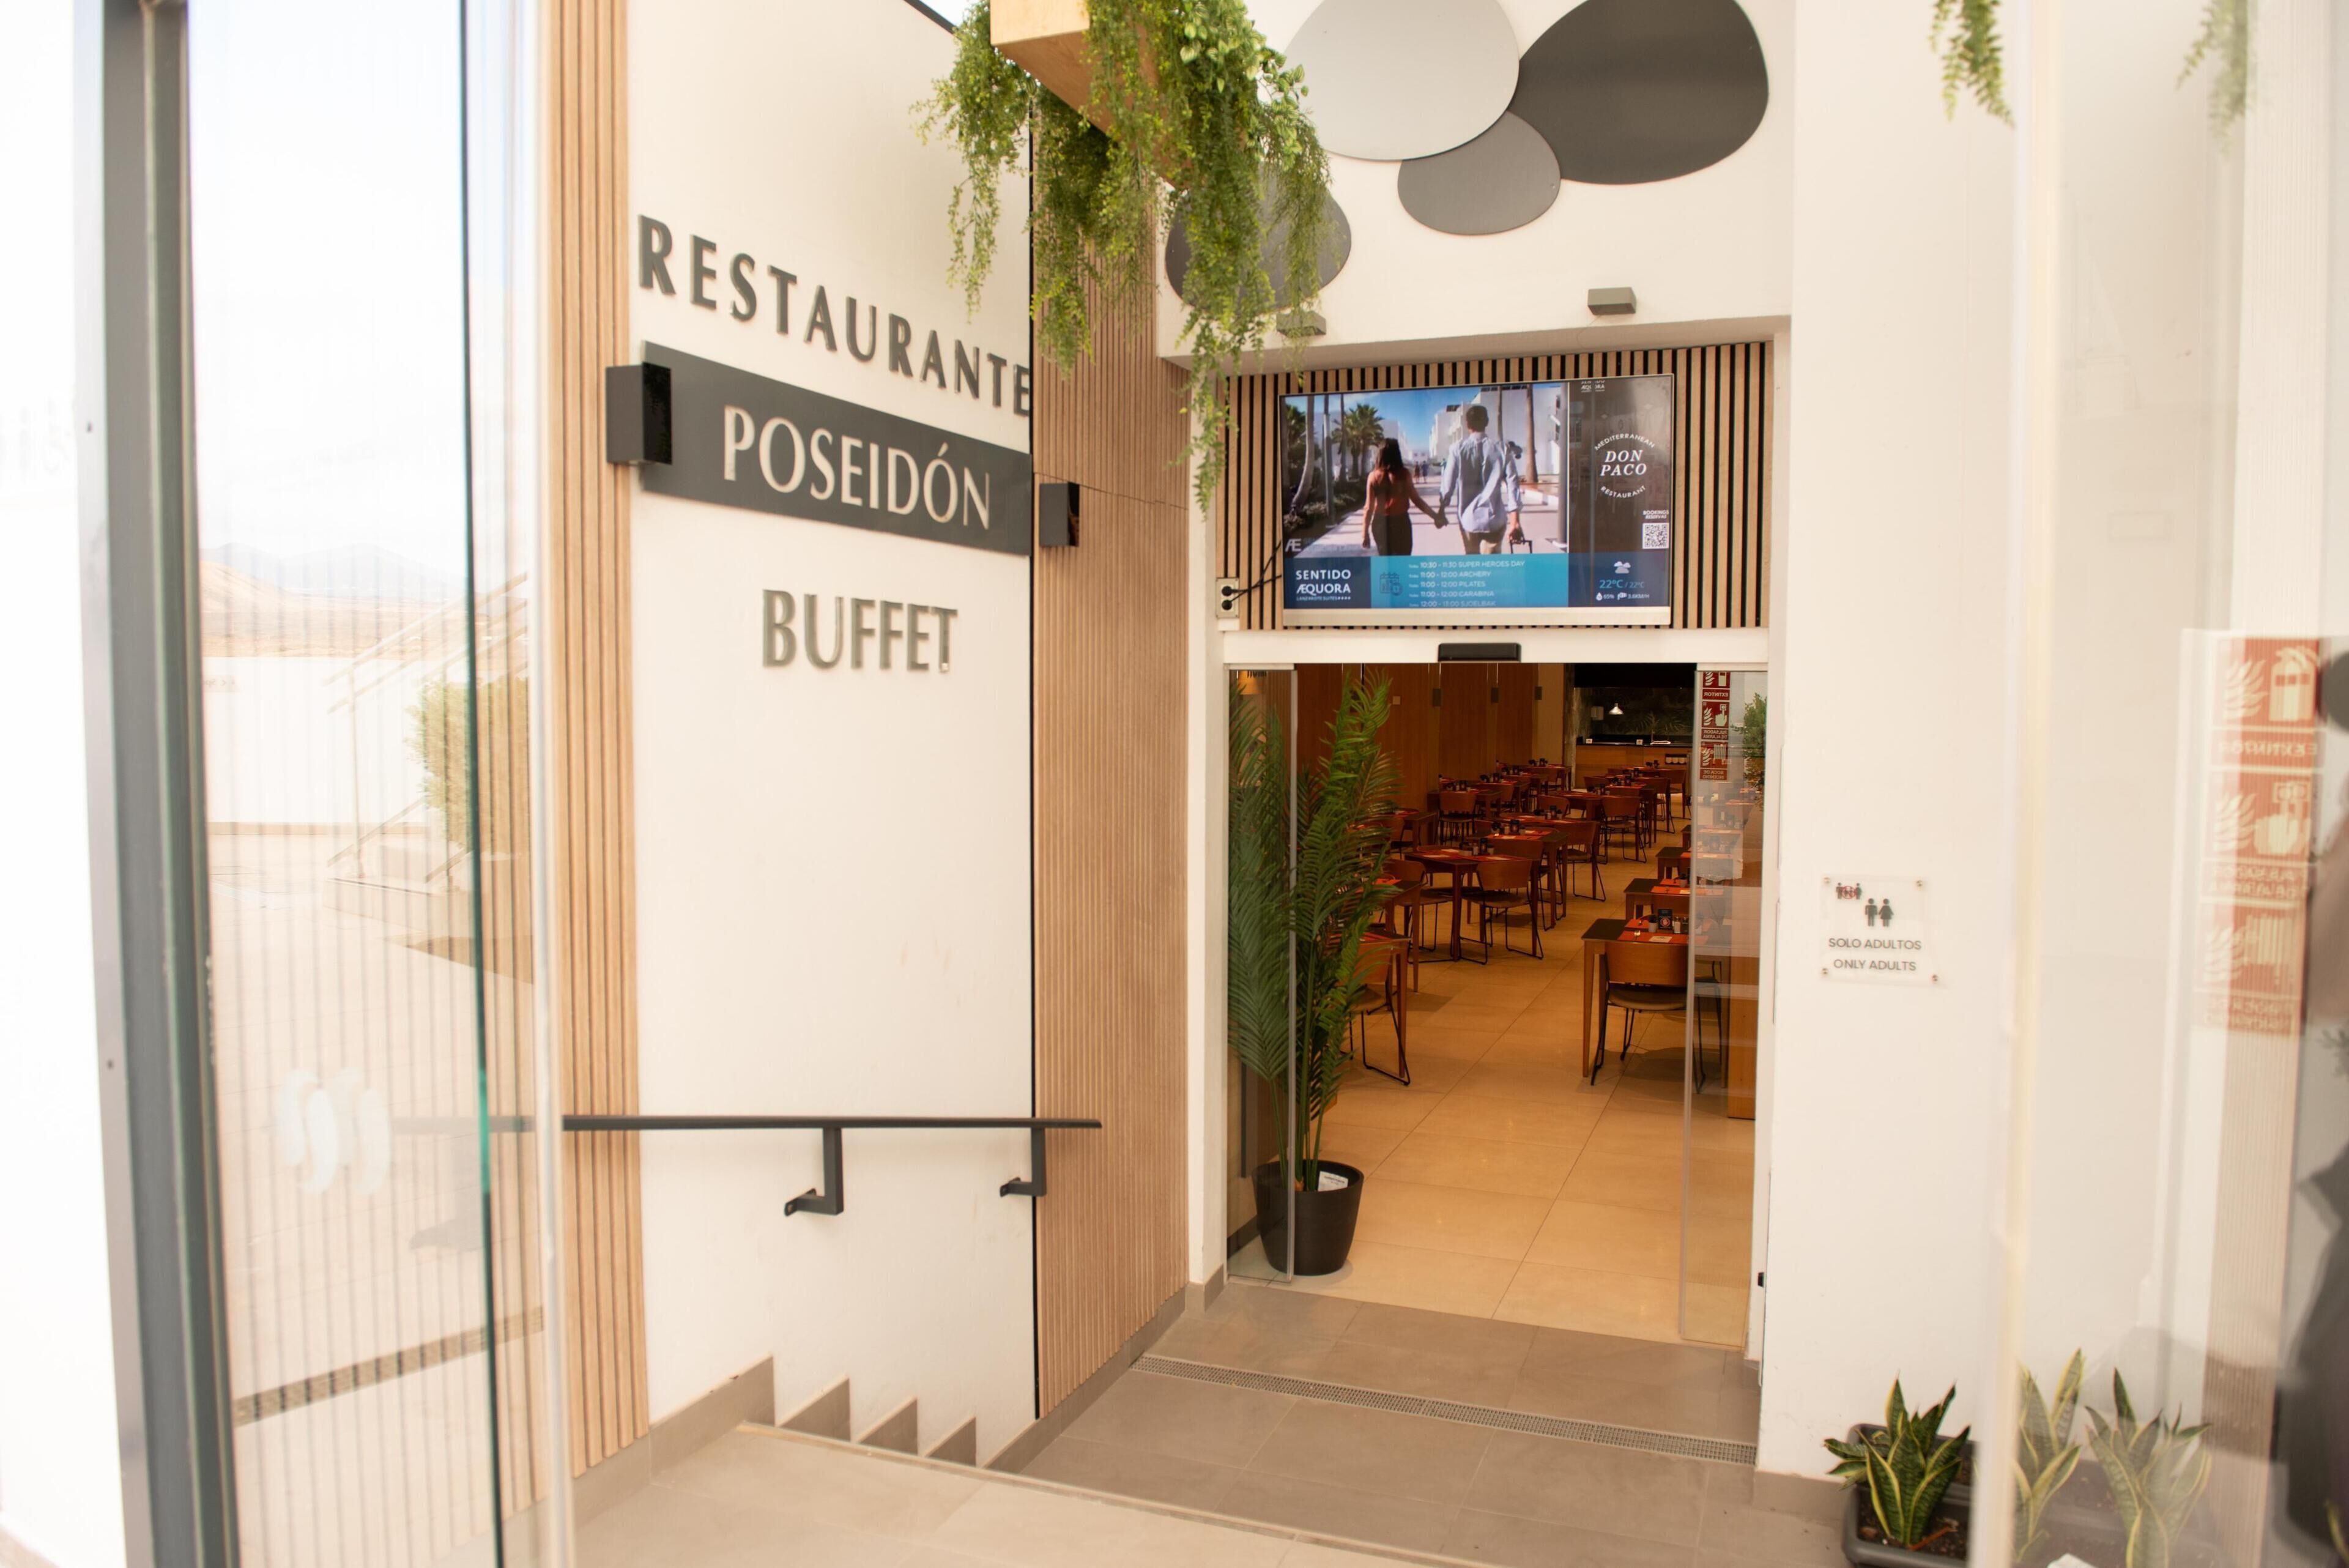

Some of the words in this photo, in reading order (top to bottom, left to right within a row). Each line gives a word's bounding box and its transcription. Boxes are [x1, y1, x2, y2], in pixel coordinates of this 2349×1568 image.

[637, 214, 1030, 417] RESTAURANTE
[1594, 433, 1655, 450] MEDITERRANEAN
[1605, 450, 1643, 463] DON
[724, 405, 990, 530] POSEIDÓN
[1600, 463, 1647, 476] PACO
[1600, 485, 1646, 498] RESTAURANT
[1296, 570, 1351, 580] SENTIDO
[1296, 583, 1351, 596] ÆQUORA
[762, 589, 958, 672] BUFFET
[1828, 938, 1861, 948] SOLO
[1865, 939, 1921, 949] ADULTOS
[1834, 959, 1866, 969] ONLY
[1869, 960, 1917, 971] ADULTS
